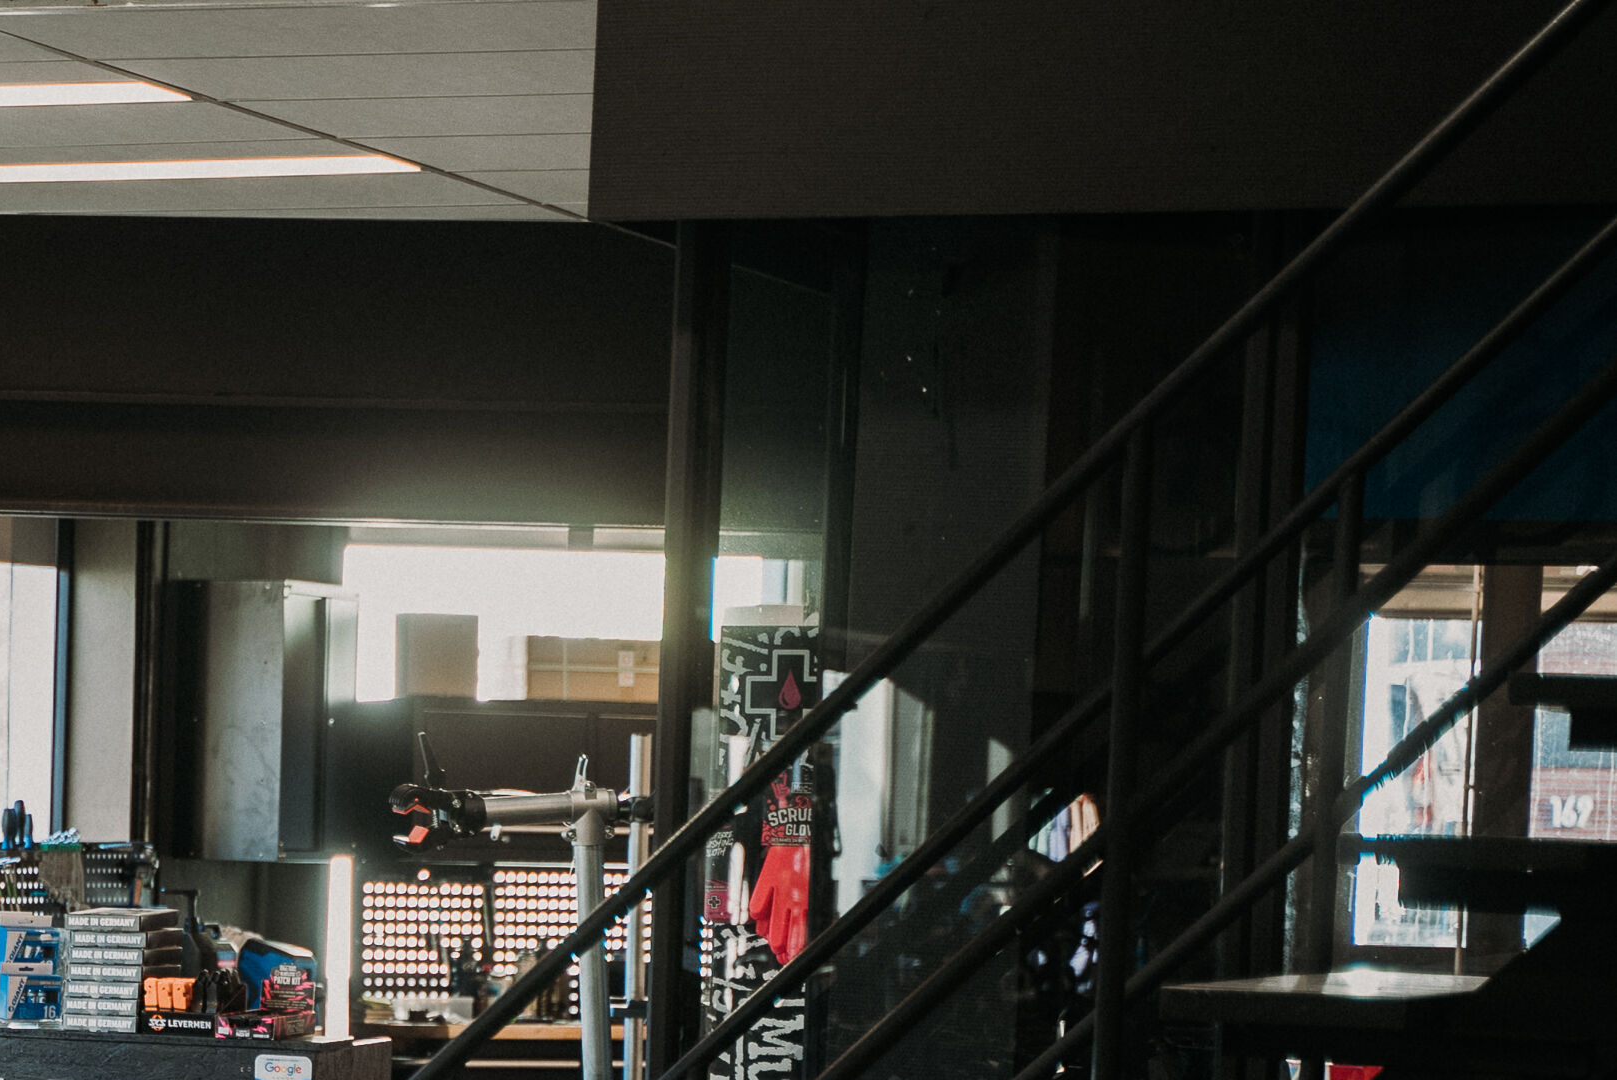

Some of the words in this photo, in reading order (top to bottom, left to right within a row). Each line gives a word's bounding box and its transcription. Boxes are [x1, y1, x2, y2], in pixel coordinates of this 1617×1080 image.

[68, 917, 89, 926] MADE
[90, 917, 98, 926] IN
[100, 917, 136, 927] GERMANY
[75, 934, 95, 943] MADE
[97, 934, 105, 944] IN
[106, 934, 142, 945] GERMANY
[72, 950, 92, 959] MADE
[94, 950, 102, 960] IN
[103, 950, 139, 961] GERMANY
[70, 966, 91, 975] MADE
[92, 966, 101, 976] IN
[102, 966, 138, 977] GERMANY
[273, 976, 291, 985] PATCH
[292, 977, 301, 985] KIT
[11, 978, 25, 1007] GIANT
[68, 984, 88, 993] MADE
[90, 984, 98, 994] IN
[99, 984, 135, 995] GERMANY
[44, 1004, 57, 1019] 16
[67, 1001, 87, 1010] MADE
[88, 1001, 96, 1011] IN
[97, 1001, 133, 1012] GERMANY
[67, 1017, 87, 1026] MADE
[88, 1017, 96, 1027] IN
[98, 1017, 133, 1029] GERMANY
[167, 1019, 212, 1030] LEVERMEN
[264, 1061, 302, 1077] Google
